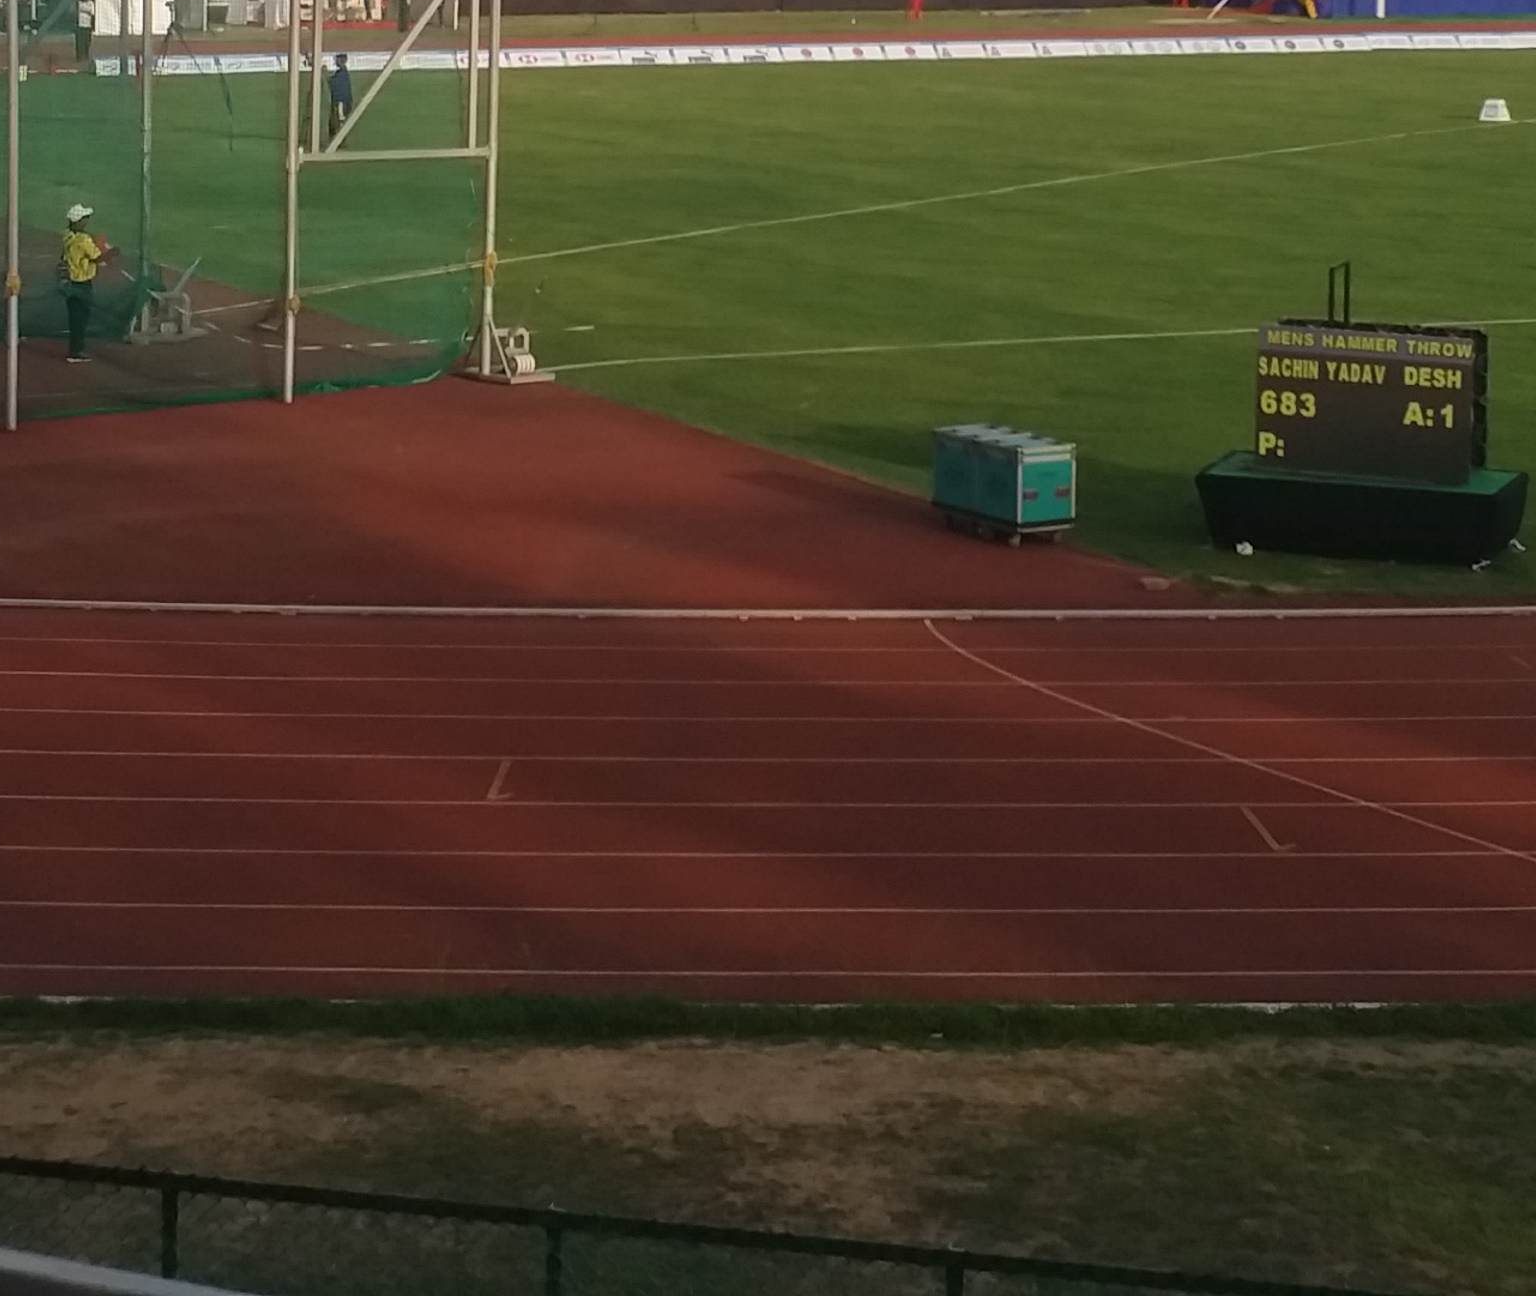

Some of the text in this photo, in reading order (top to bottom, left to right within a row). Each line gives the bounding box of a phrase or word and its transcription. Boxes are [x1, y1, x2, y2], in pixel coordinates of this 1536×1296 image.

[1267, 330, 1473, 358] MENS HAMMER THROW
[1258, 357, 1462, 389] SACHIN YADAV DESH
[1260, 390, 1316, 418] 683
[1258, 431, 1285, 457] P:
